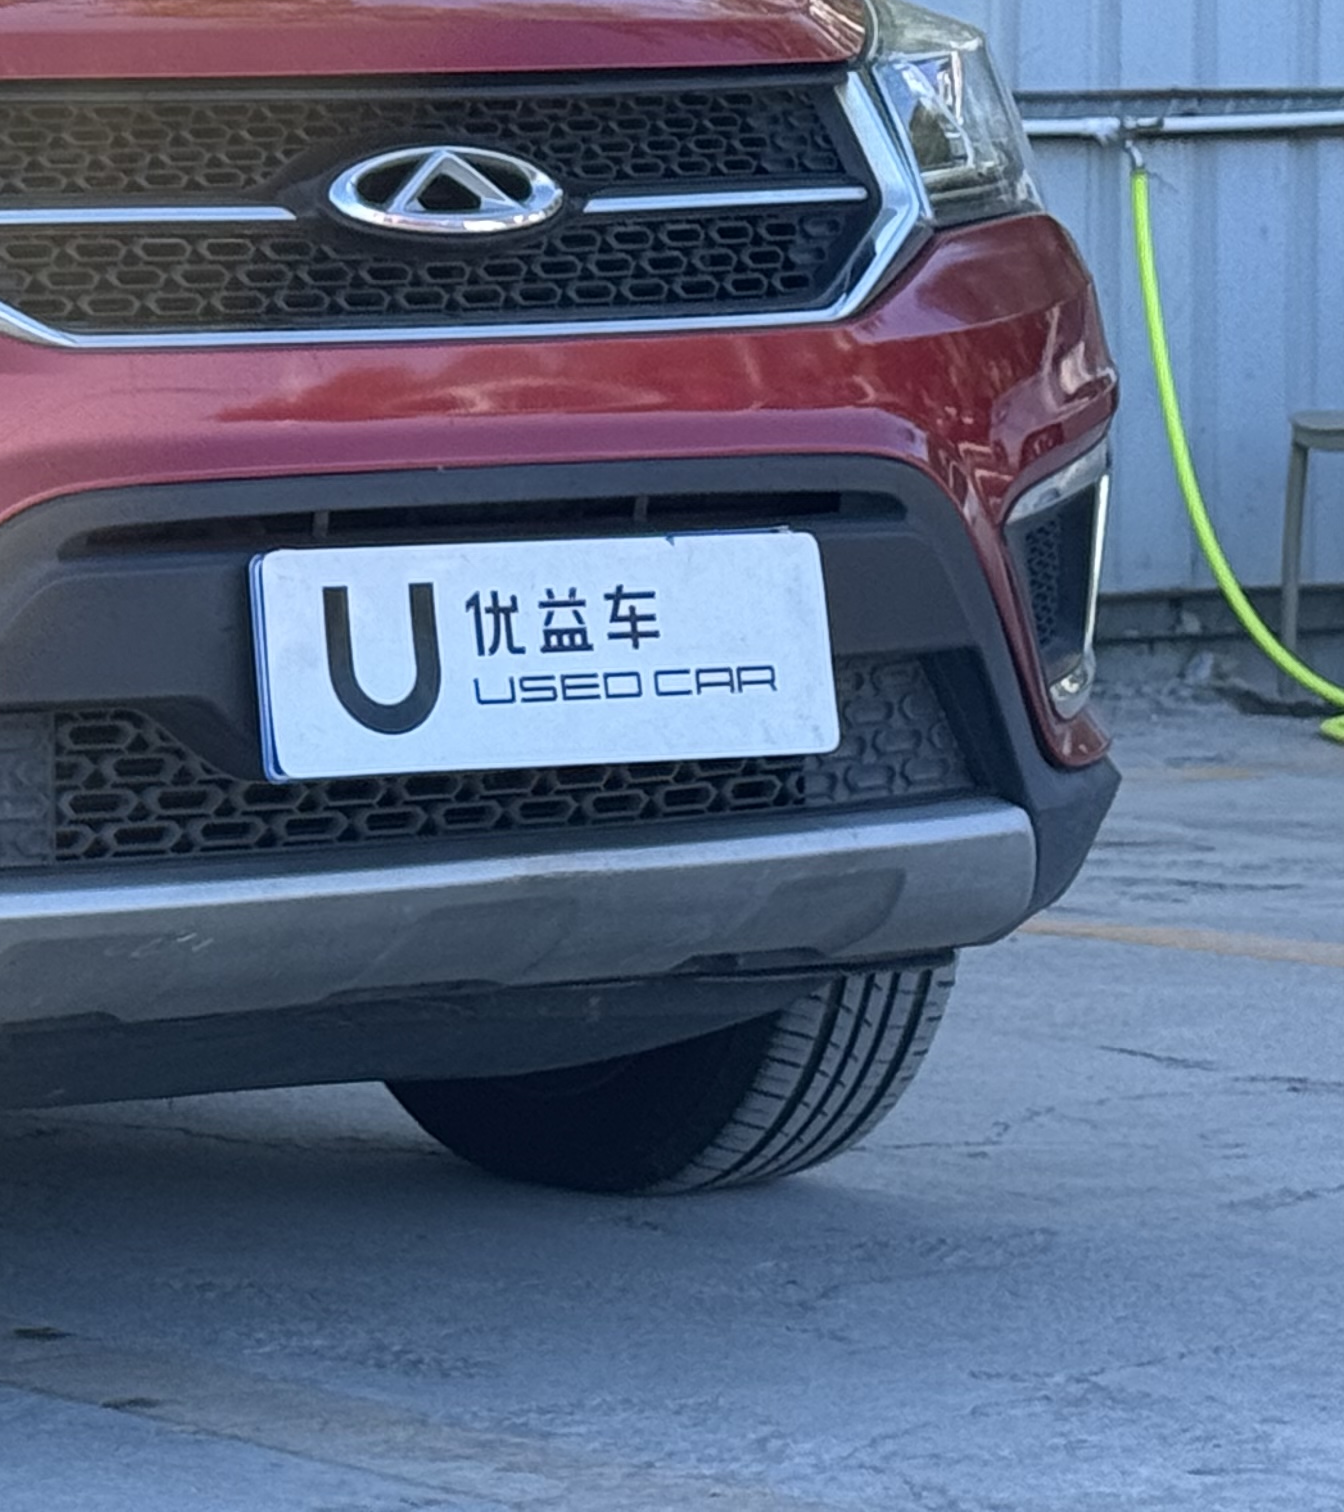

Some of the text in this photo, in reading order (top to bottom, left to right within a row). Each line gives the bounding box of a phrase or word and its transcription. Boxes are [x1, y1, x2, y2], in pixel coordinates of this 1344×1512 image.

[465, 584, 661, 657] 优益车
[321, 582, 442, 735] U
[473, 665, 778, 706] USED CAR
